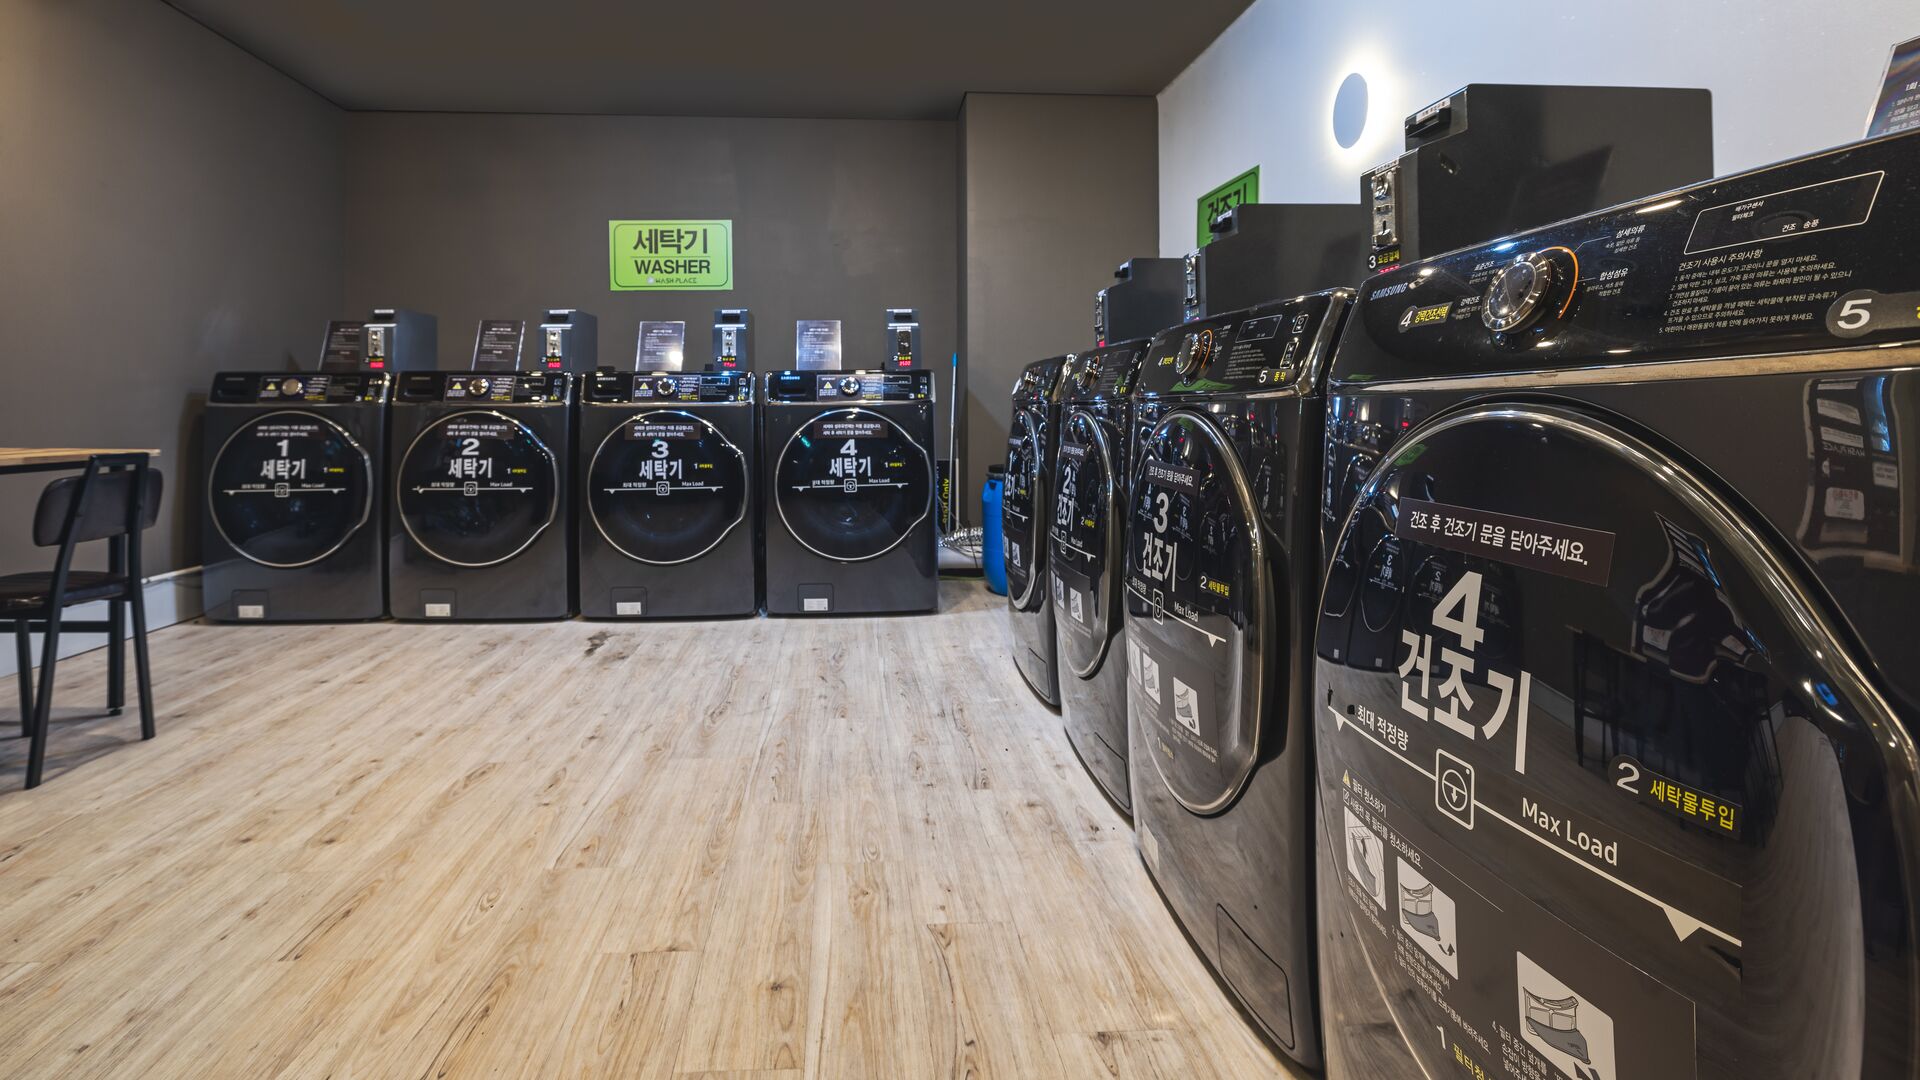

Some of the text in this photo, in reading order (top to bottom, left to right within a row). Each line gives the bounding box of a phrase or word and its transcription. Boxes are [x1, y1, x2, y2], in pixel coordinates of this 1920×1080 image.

[1616, 224, 1646, 239] 섬세의류
[1782, 219, 1820, 233] 건조 송풍
[633, 229, 707, 254] 세탁기
[634, 260, 711, 274] WASHER
[1368, 255, 1376, 269] 3
[1378, 249, 1399, 264] 요금결제
[1678, 249, 1763, 271] 건조기 사용시 주의사항
[1721, 265, 1739, 275] 온도가
[1795, 254, 1818, 263] 마세요.
[1798, 261, 1836, 272] 주의하세요.
[1600, 267, 1629, 281] 합성섬유
[1829, 270, 1852, 280] 있으니
[1370, 282, 1409, 301] SAMSUNG
[1807, 290, 1838, 301] 금속류가
[1400, 310, 1413, 327] 4
[1415, 305, 1450, 324] 강력건조선택
[1714, 308, 1745, 319] 주의하세요.
[1791, 312, 1814, 321] 하세요.
[1837, 298, 1872, 330] 5
[1258, 370, 1286, 383] 5 동작
[1113, 385, 1119, 395] 5
[276, 439, 289, 457] 1
[461, 438, 480, 455] 2
[651, 440, 669, 459] 3
[840, 439, 858, 456] 4
[260, 459, 306, 480] 세탁기
[448, 457, 492, 479] 세탁기
[638, 459, 682, 480] 세탁기
[829, 456, 871, 478] 세탁기
[1062, 466, 1072, 495] 2
[1153, 492, 1169, 534] 3
[1410, 510, 1588, 566] 건조 후 건조기 문을 닫아주세요.
[1142, 532, 1178, 593] 건조기
[1200, 575, 1230, 597] 2 세탁물투입
[1174, 601, 1199, 622] Max Load
[1432, 571, 1484, 652] 4
[1398, 629, 1532, 775] 건조기
[1356, 704, 1409, 752] 최대 적정량
[1352, 778, 1386, 818] 필터 청소하기
[1616, 762, 1735, 832] 2 세탁물투입
[1522, 797, 1618, 867] Max Load
[1371, 816, 1388, 840] 필터를
[1389, 831, 1423, 870] 청소하세요.
[1436, 1025, 1446, 1050] 1
[1492, 1020, 1499, 1033] 4.
[1499, 1024, 1511, 1046] 필터
[1513, 1037, 1526, 1058] 중간
